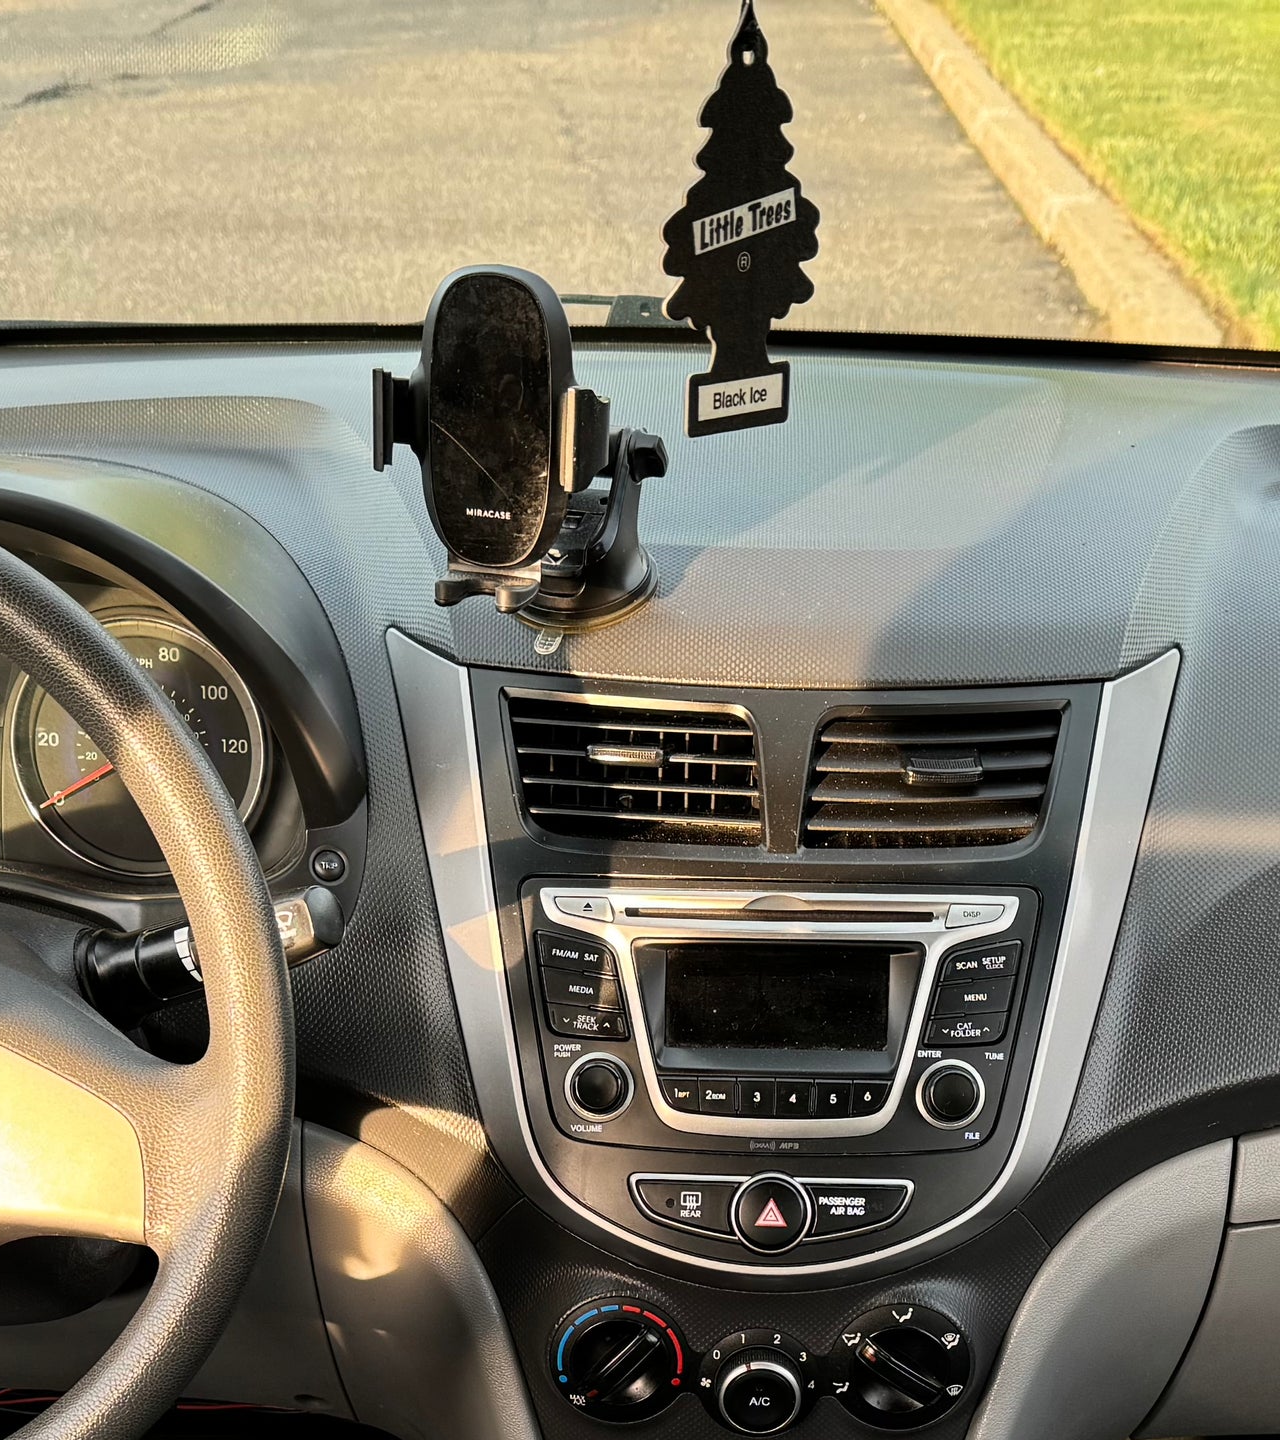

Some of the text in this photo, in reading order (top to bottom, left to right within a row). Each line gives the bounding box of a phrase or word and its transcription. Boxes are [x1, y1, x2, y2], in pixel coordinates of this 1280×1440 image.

[700, 197, 792, 251] Little Trees
[713, 386, 768, 410] Black Ice
[465, 507, 511, 520] MIRACASE
[158, 647, 180, 662] 80
[135, 656, 154, 669] PH
[200, 685, 228, 701] 100
[37, 732, 60, 747] 20
[221, 738, 248, 754] 120
[85, 751, 98, 761] 20
[551, 948, 599, 963] FM/AM SAT
[955, 956, 1006, 970] SCAN SETUP
[568, 984, 594, 995] MEDIA
[964, 993, 987, 1002] MENU
[577, 1014, 597, 1024] SEEK
[573, 1021, 599, 1031] TRACK
[956, 1022, 972, 1031] CAT
[950, 1029, 982, 1038] FOLDER
[553, 1043, 582, 1052] POWER
[917, 1050, 942, 1059] ENTER
[984, 1052, 1004, 1061] TUNE
[753, 1091, 761, 1103] 3
[788, 1093, 797, 1104] 4
[829, 1093, 837, 1105] 5
[864, 1091, 871, 1102] 6
[570, 1124, 602, 1133] VOLUME
[964, 1132, 980, 1140] FILE
[819, 1196, 866, 1206] PASSENGER
[680, 1210, 701, 1218] REAR
[830, 1206, 866, 1216] AIR BAG
[740, 1333, 745, 1344] 1
[773, 1333, 781, 1345] 2
[712, 1349, 721, 1360] 0
[799, 1351, 807, 1362] 3
[807, 1379, 815, 1389] 4
[748, 1396, 771, 1407] A/C
